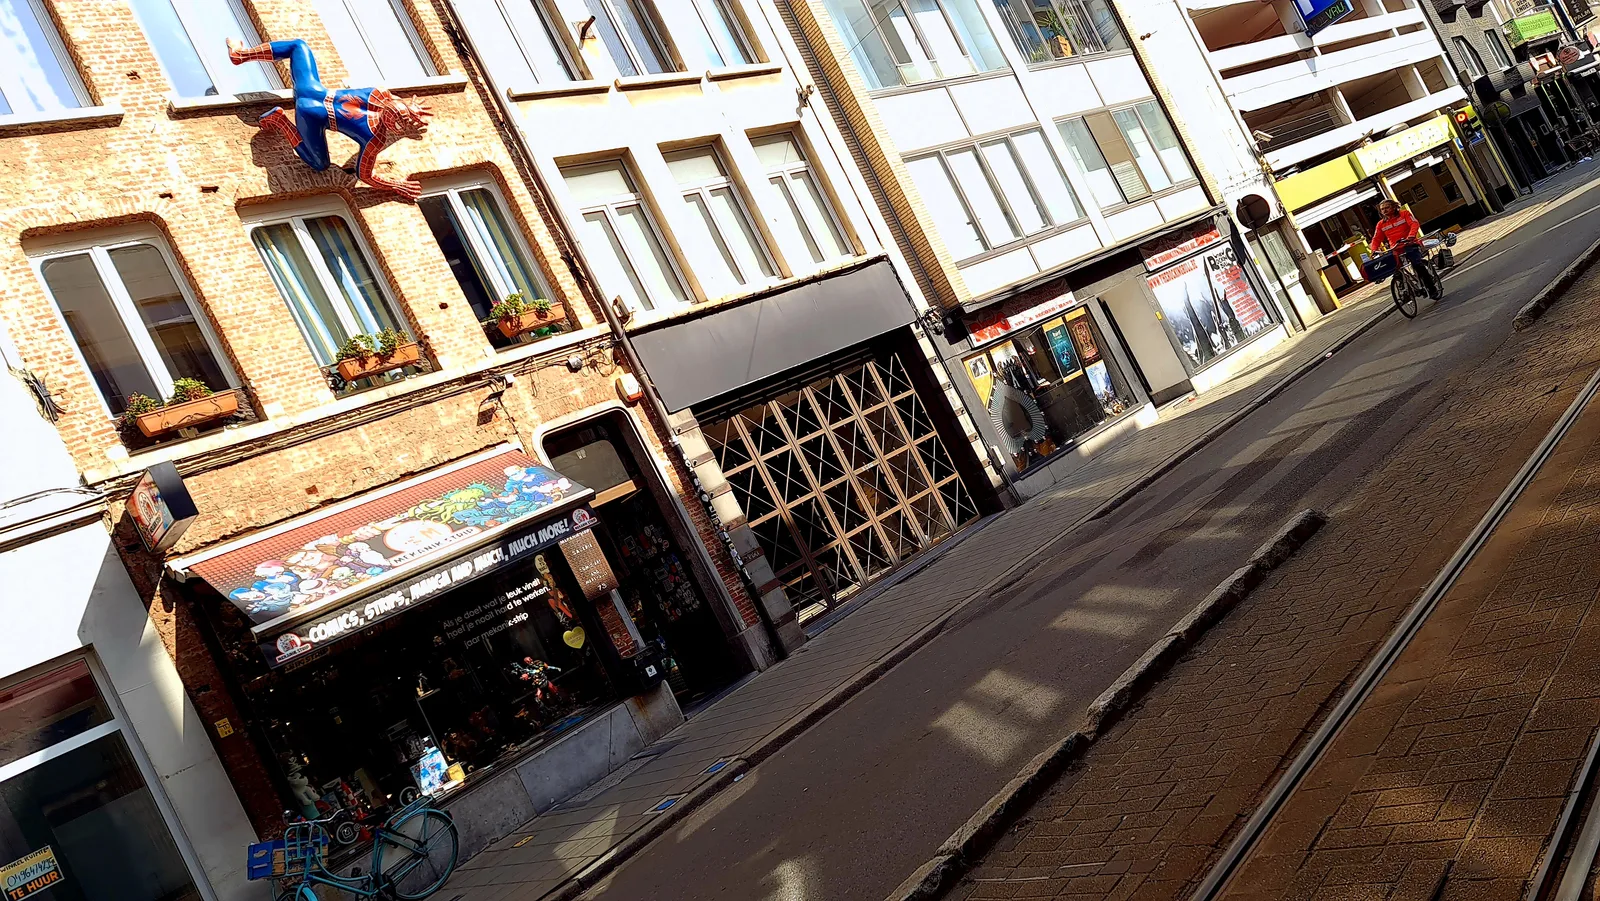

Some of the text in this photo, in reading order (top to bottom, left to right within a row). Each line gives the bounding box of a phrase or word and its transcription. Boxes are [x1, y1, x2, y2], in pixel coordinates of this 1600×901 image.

[1573, 9, 1591, 22] PALM
[308, 610, 364, 643] COMICS,
[364, 590, 409, 620] STRIPS,
[410, 570, 450, 599] MANGA
[451, 560, 473, 583] AND
[474, 547, 509, 573] MUCH,
[508, 534, 538, 557] MUCH
[539, 518, 569, 544] MORE!
[443, 577, 541, 630] Als je doet wat je leuk vindt
[446, 585, 551, 640] hoef je nooit hard te werken.
[464, 634, 481, 649] jaar
[9, 870, 59, 901] TE HUUR
